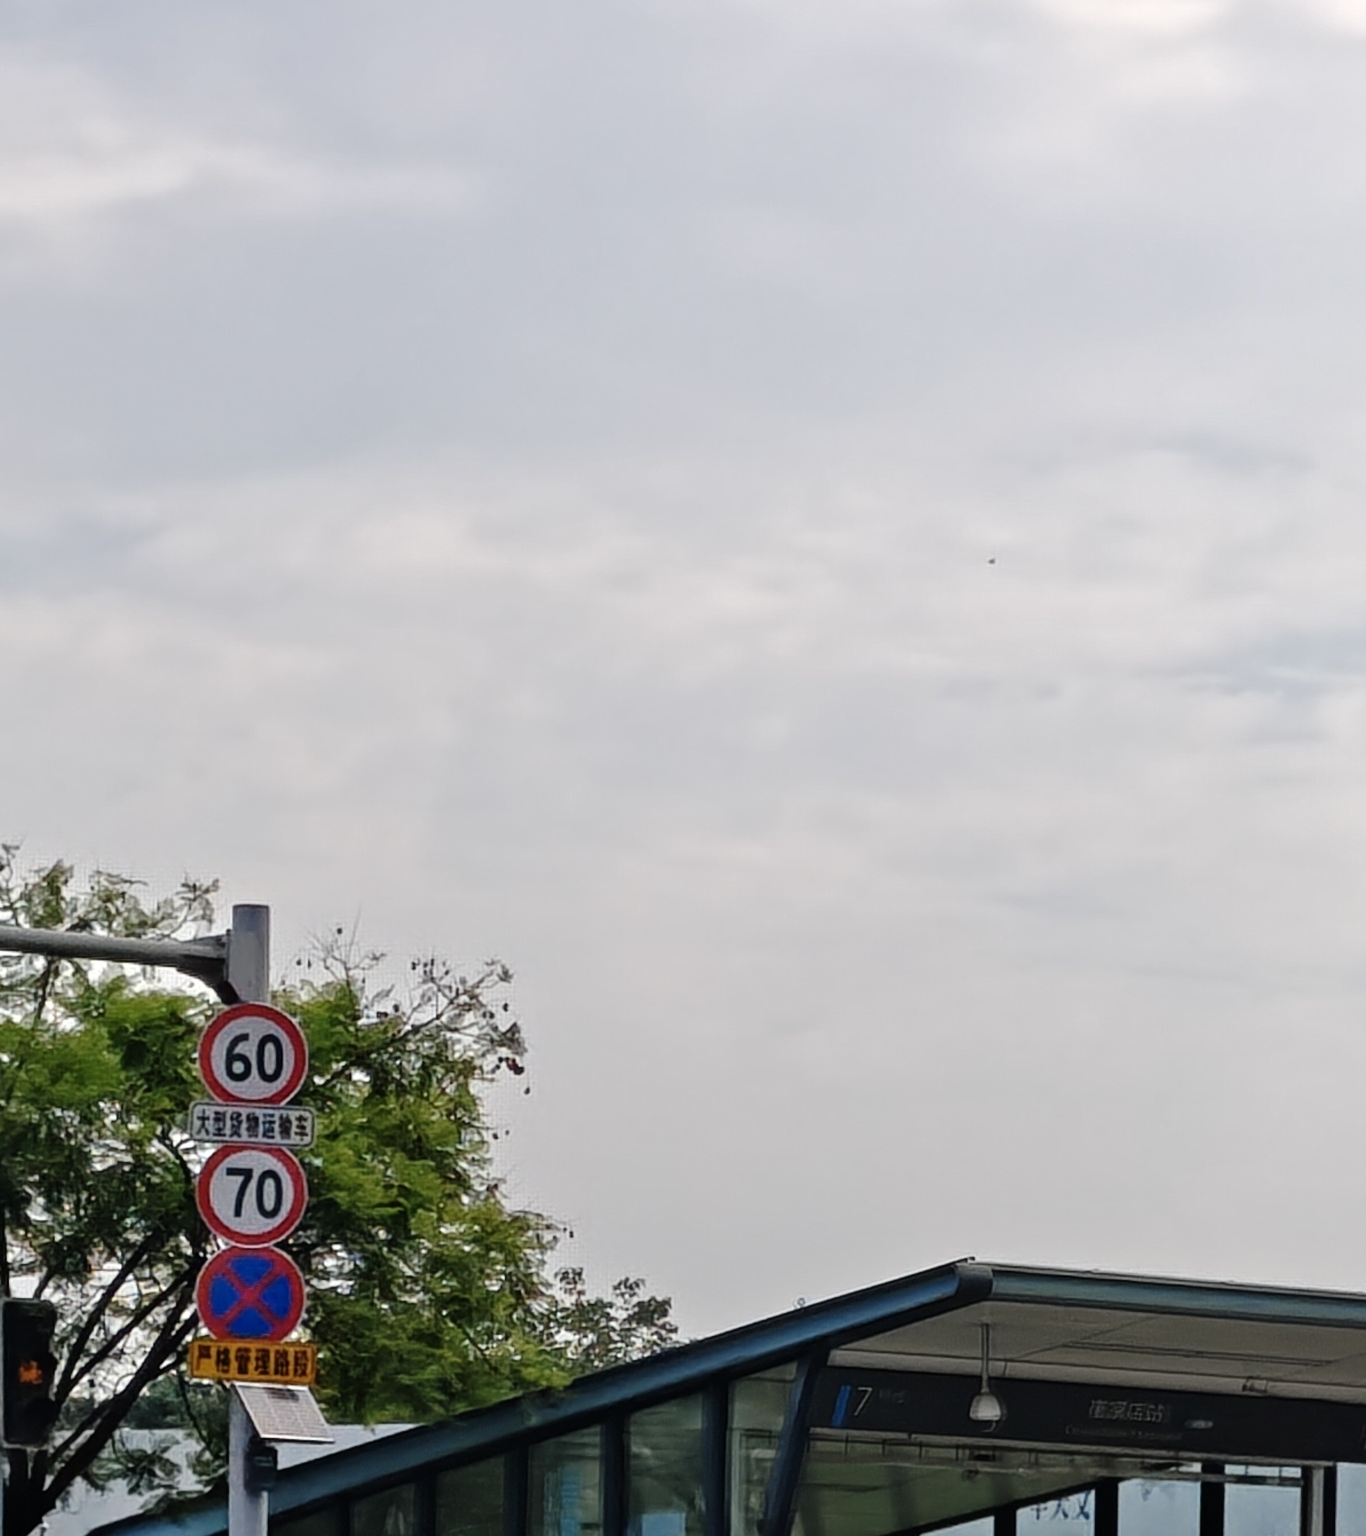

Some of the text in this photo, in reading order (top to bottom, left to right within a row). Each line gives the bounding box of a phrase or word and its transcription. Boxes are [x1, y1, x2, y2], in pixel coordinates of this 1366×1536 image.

[224, 1032, 284, 1083] 60
[225, 1167, 284, 1220] 70
[194, 1344, 309, 1378] 严格管理路段
